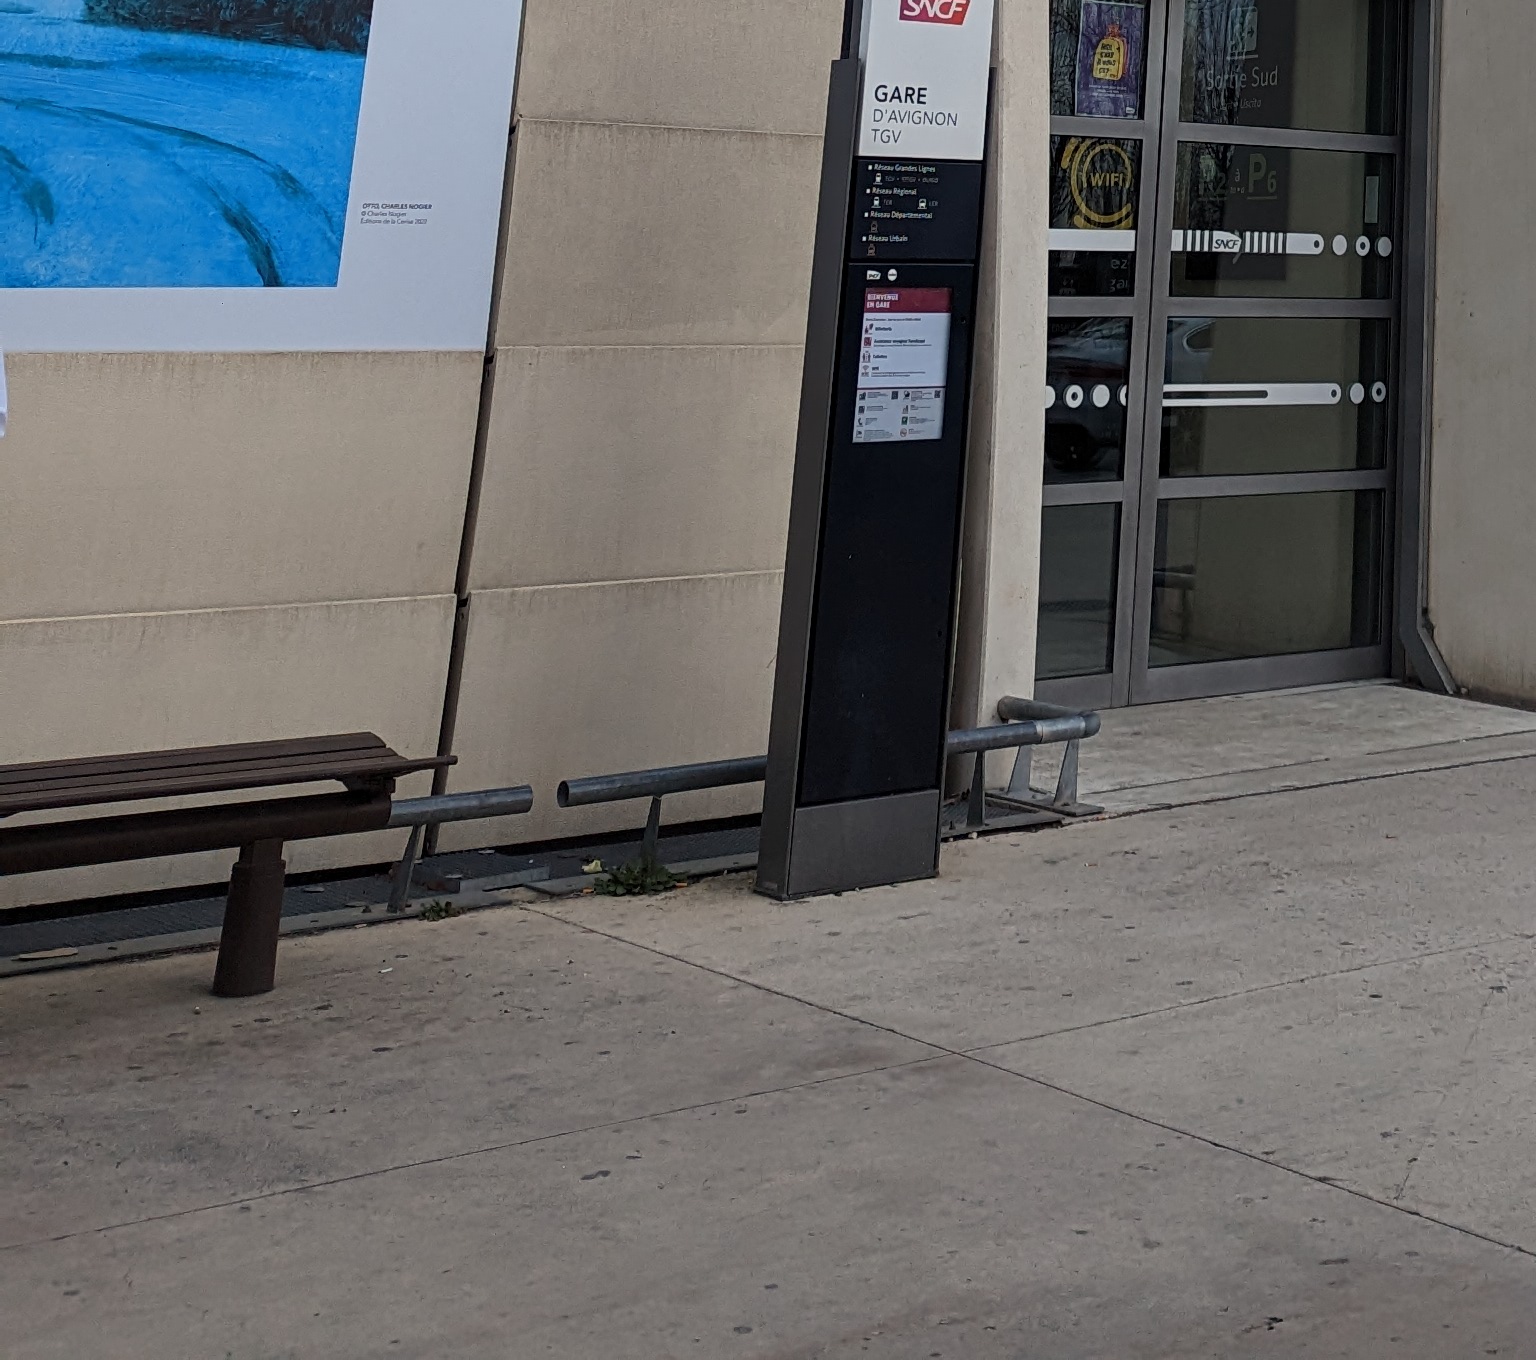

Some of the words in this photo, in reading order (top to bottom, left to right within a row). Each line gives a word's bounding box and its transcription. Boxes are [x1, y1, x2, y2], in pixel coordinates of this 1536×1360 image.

[1251, 65, 1278, 88] Sud
[874, 84, 928, 105] GARE
[872, 108, 958, 127] D'AVIGNON
[871, 128, 902, 144] TGV
[873, 163, 894, 172] Réseau
[894, 164, 917, 172] Grandes
[918, 165, 936, 173] Lignes
[1248, 152, 1277, 194] P6
[1090, 172, 1125, 187] WIFI
[872, 187, 892, 195] Réseau
[893, 187, 917, 196] Régional
[869, 210, 890, 218] Réseau
[891, 211, 933, 219] Départemental
[868, 234, 888, 242] Réseau
[1213, 238, 1240, 250] SNCF
